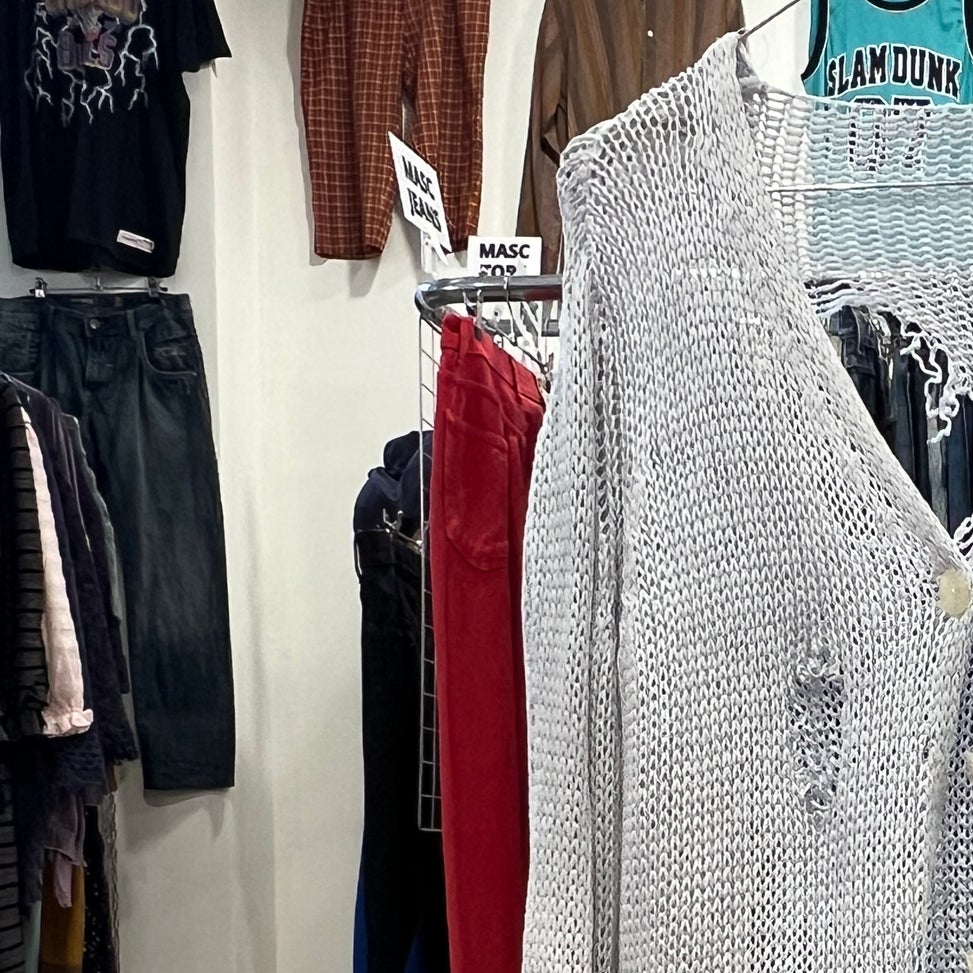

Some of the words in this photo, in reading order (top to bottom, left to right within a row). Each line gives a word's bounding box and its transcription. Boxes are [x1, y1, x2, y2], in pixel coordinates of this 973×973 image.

[827, 43, 888, 98] SLAM
[890, 43, 962, 102] DUNK
[401, 155, 435, 201] MASC
[479, 243, 530, 259] MASC
